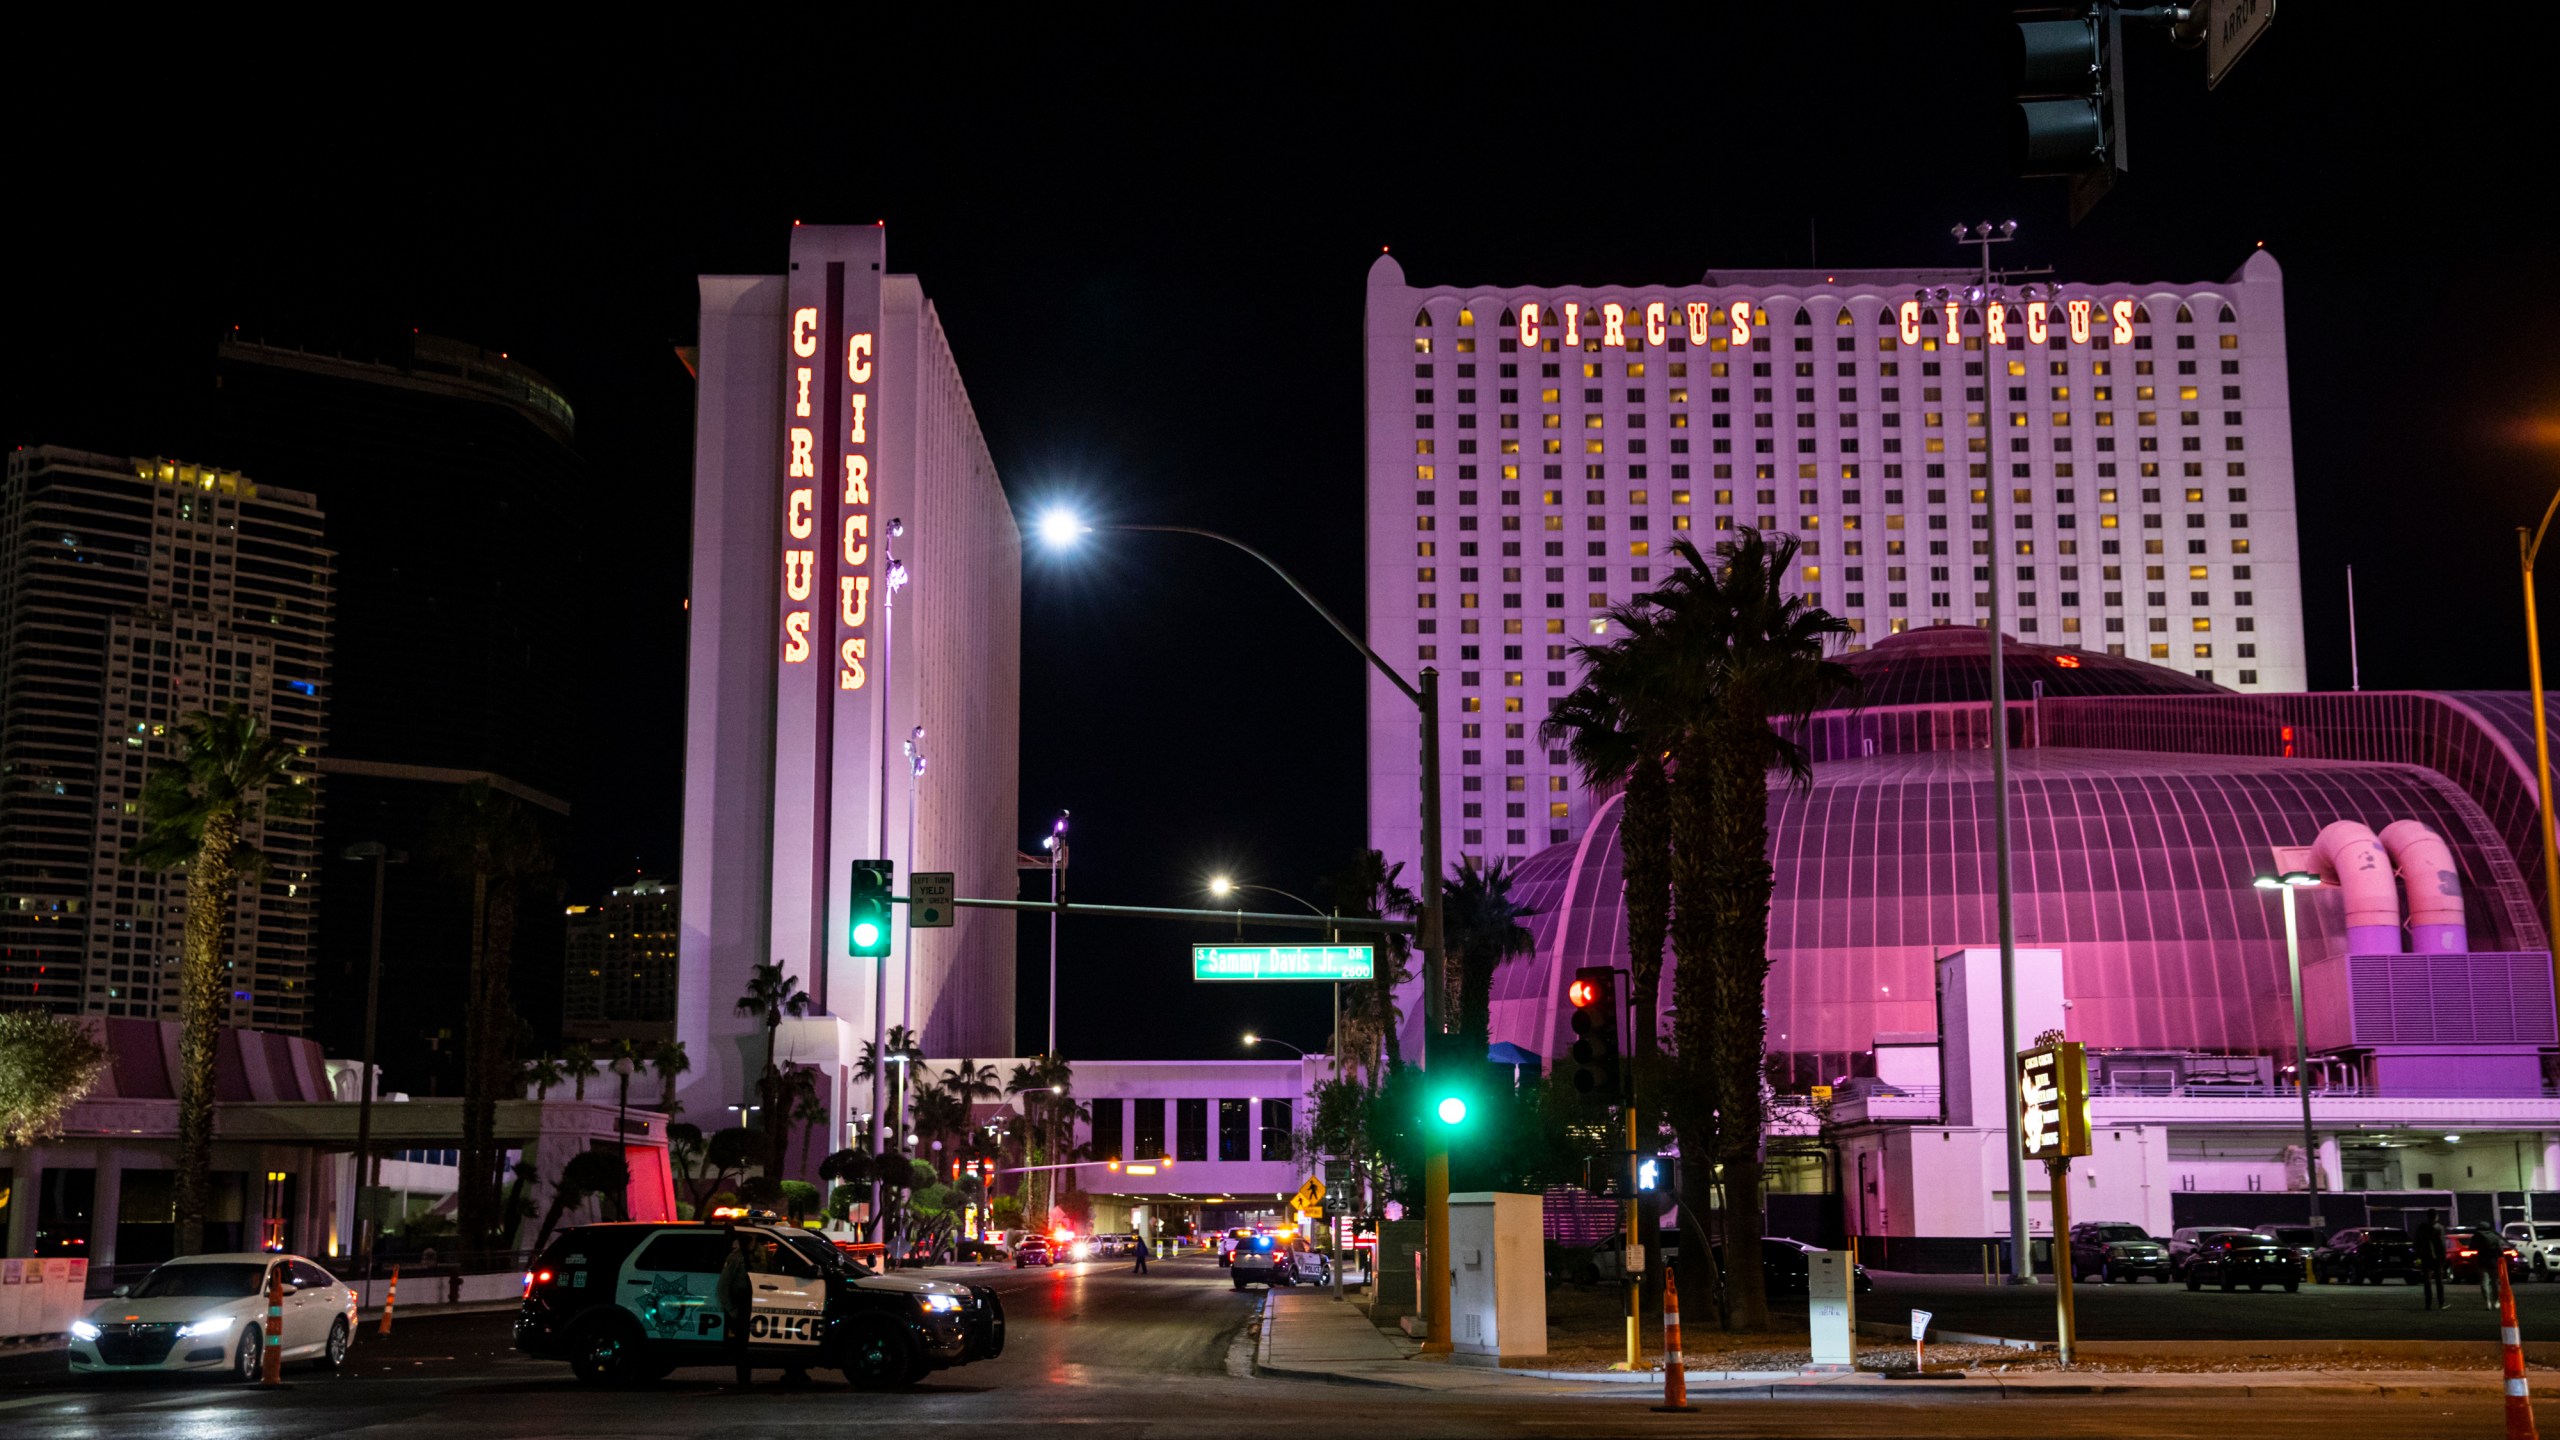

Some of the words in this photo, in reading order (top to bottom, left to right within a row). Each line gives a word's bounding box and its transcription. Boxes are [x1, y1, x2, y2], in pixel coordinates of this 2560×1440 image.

[1519, 302, 1751, 347] CIRCUS
[1900, 300, 2134, 346] CIRCUS
[784, 307, 818, 663] CIRCUS
[840, 333, 872, 690] CIRCUS
[934, 876, 950, 884] TURN
[920, 886, 945, 895] YIELD
[1197, 949, 1205, 960] S
[1348, 948, 1363, 960] DR
[1209, 948, 1261, 979] Sammy
[1270, 948, 1310, 973] Davis
[1319, 948, 1338, 973] Jr.
[1341, 965, 1371, 977] 2600
[1327, 1197, 1348, 1210] 25
[1304, 1265, 1320, 1274] POLICE
[697, 1312, 826, 1341] POLICE
